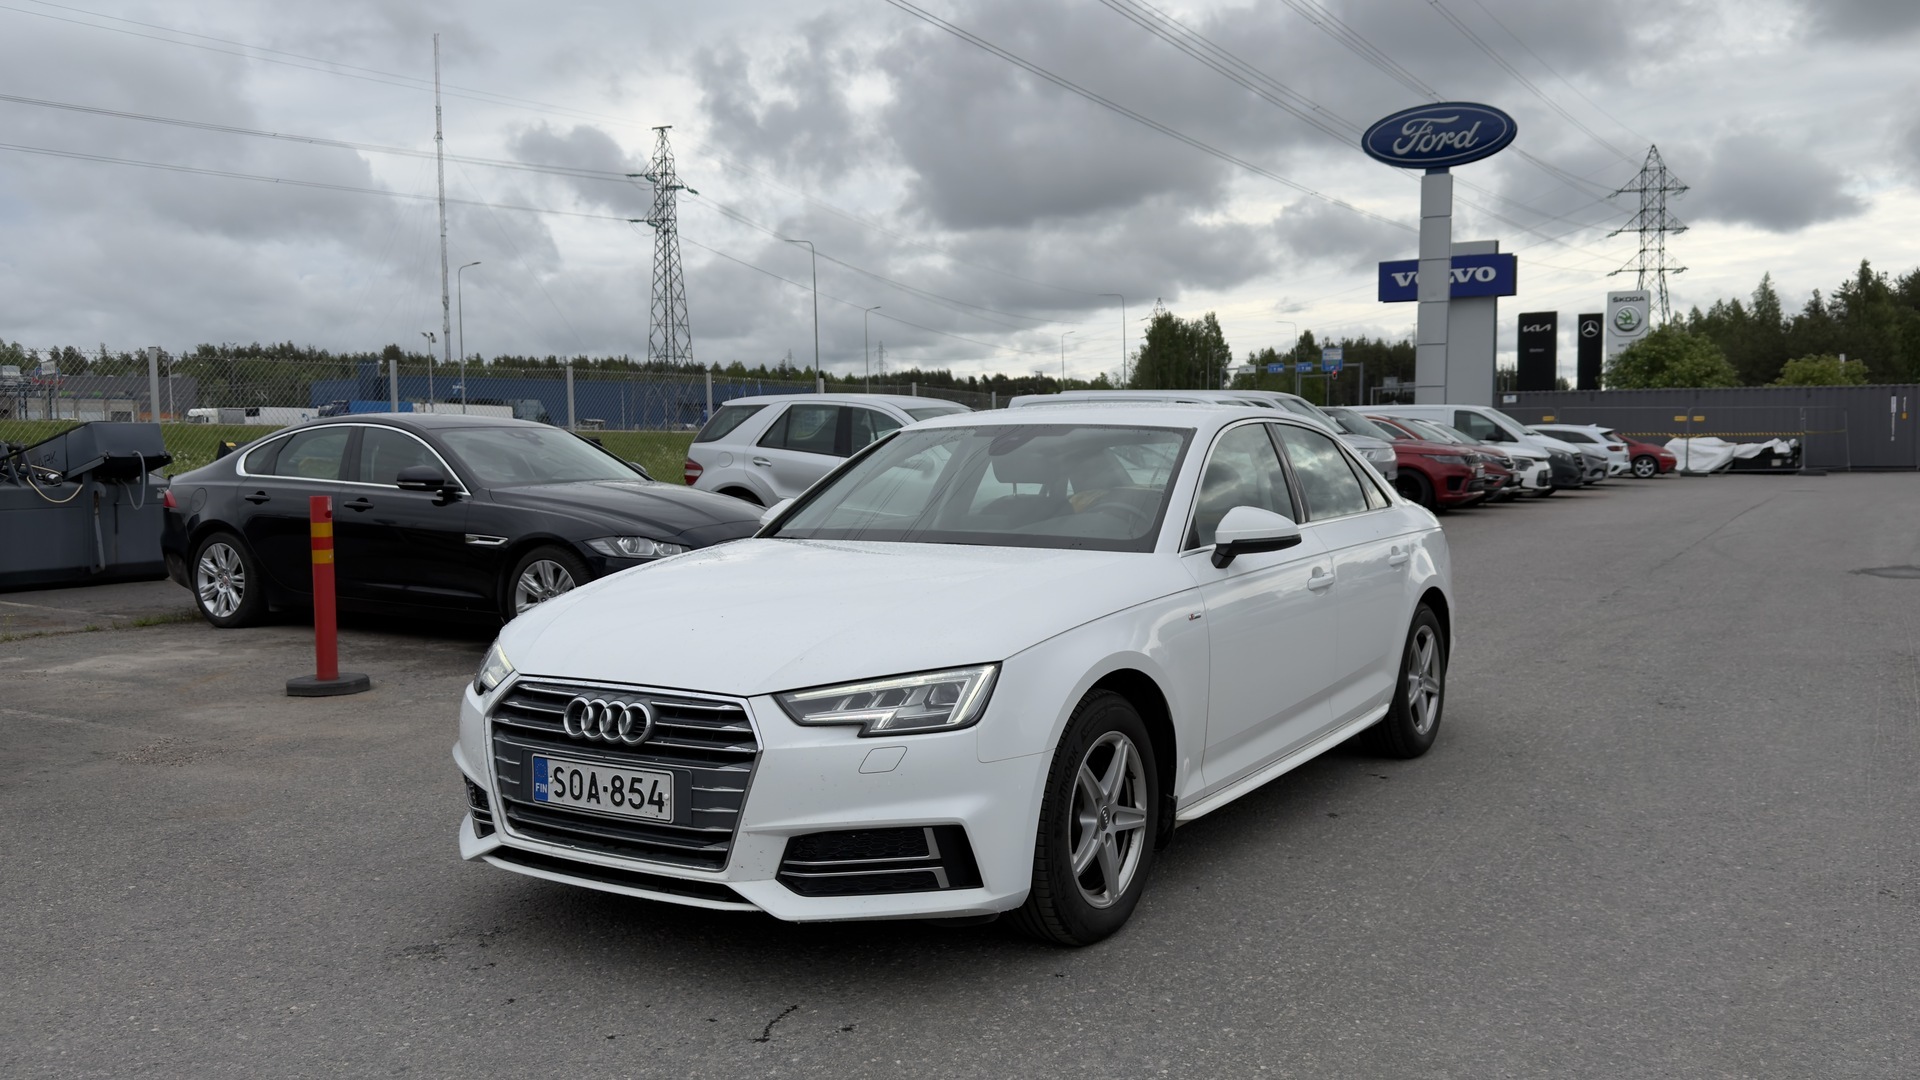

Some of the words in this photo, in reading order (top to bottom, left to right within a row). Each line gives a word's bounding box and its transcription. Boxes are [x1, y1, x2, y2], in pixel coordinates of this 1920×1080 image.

[1393, 115, 1481, 155] Ford
[1391, 266, 1497, 287] VVO
[535, 782, 548, 794] FIN
[553, 766, 665, 813] SOA-854
